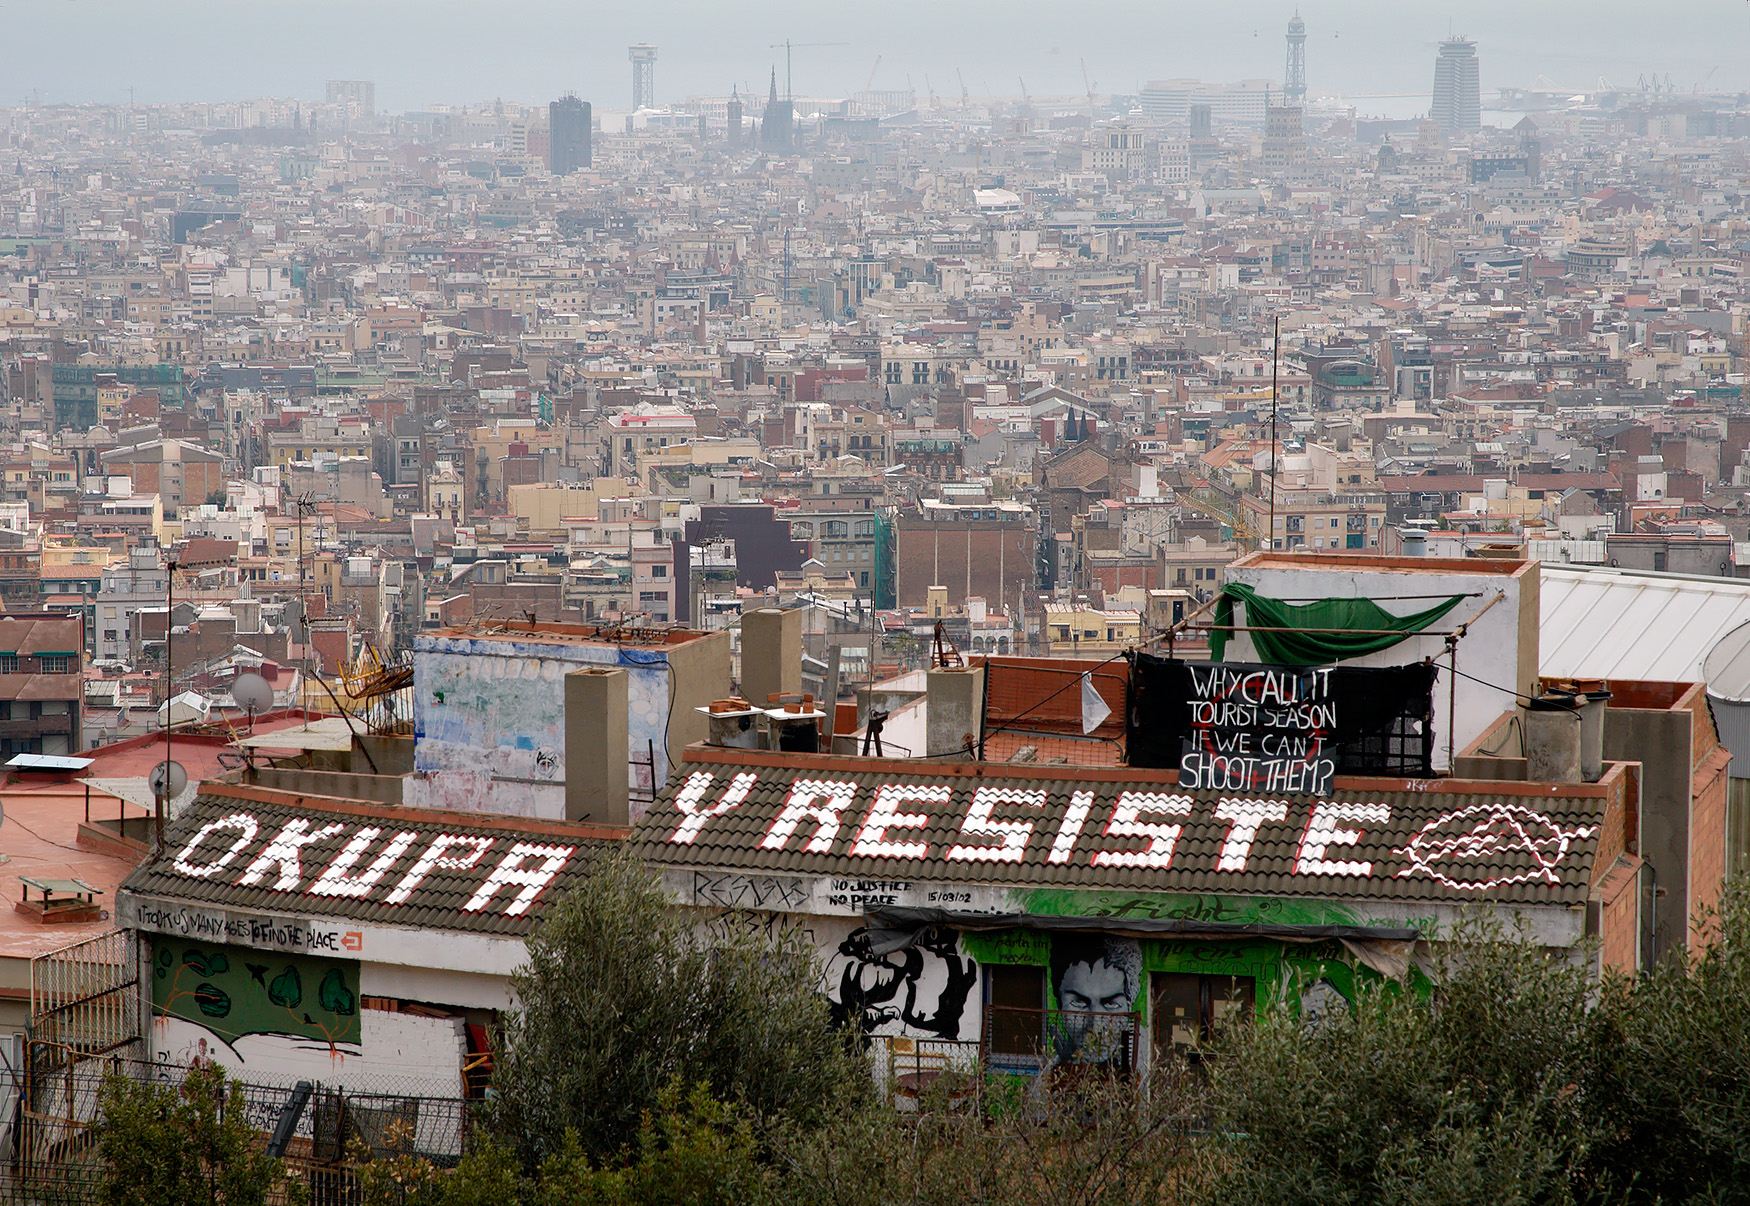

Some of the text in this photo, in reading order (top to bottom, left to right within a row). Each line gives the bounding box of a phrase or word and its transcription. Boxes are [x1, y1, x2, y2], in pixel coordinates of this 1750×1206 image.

[1190, 666, 1335, 704] WHY CALL IT
[1186, 700, 1337, 729] TOURIST SEASON
[1192, 729, 1328, 757] IF WE CAN'T
[1178, 752, 1335, 796] SHOOT THEM?
[667, 771, 1392, 876] Y RESISTE
[172, 812, 578, 920] OKUPA
[830, 880, 848, 891] NO
[927, 891, 972, 903] 15/03/02
[829, 894, 899, 912] NO PEACE
[138, 905, 148, 924] IT
[145, 909, 173, 929] TOOK
[173, 908, 189, 934] US
[190, 913, 224, 936] MANY
[224, 919, 251, 937] AGES
[283, 924, 303, 946] THE
[306, 928, 340, 951] PLACE
